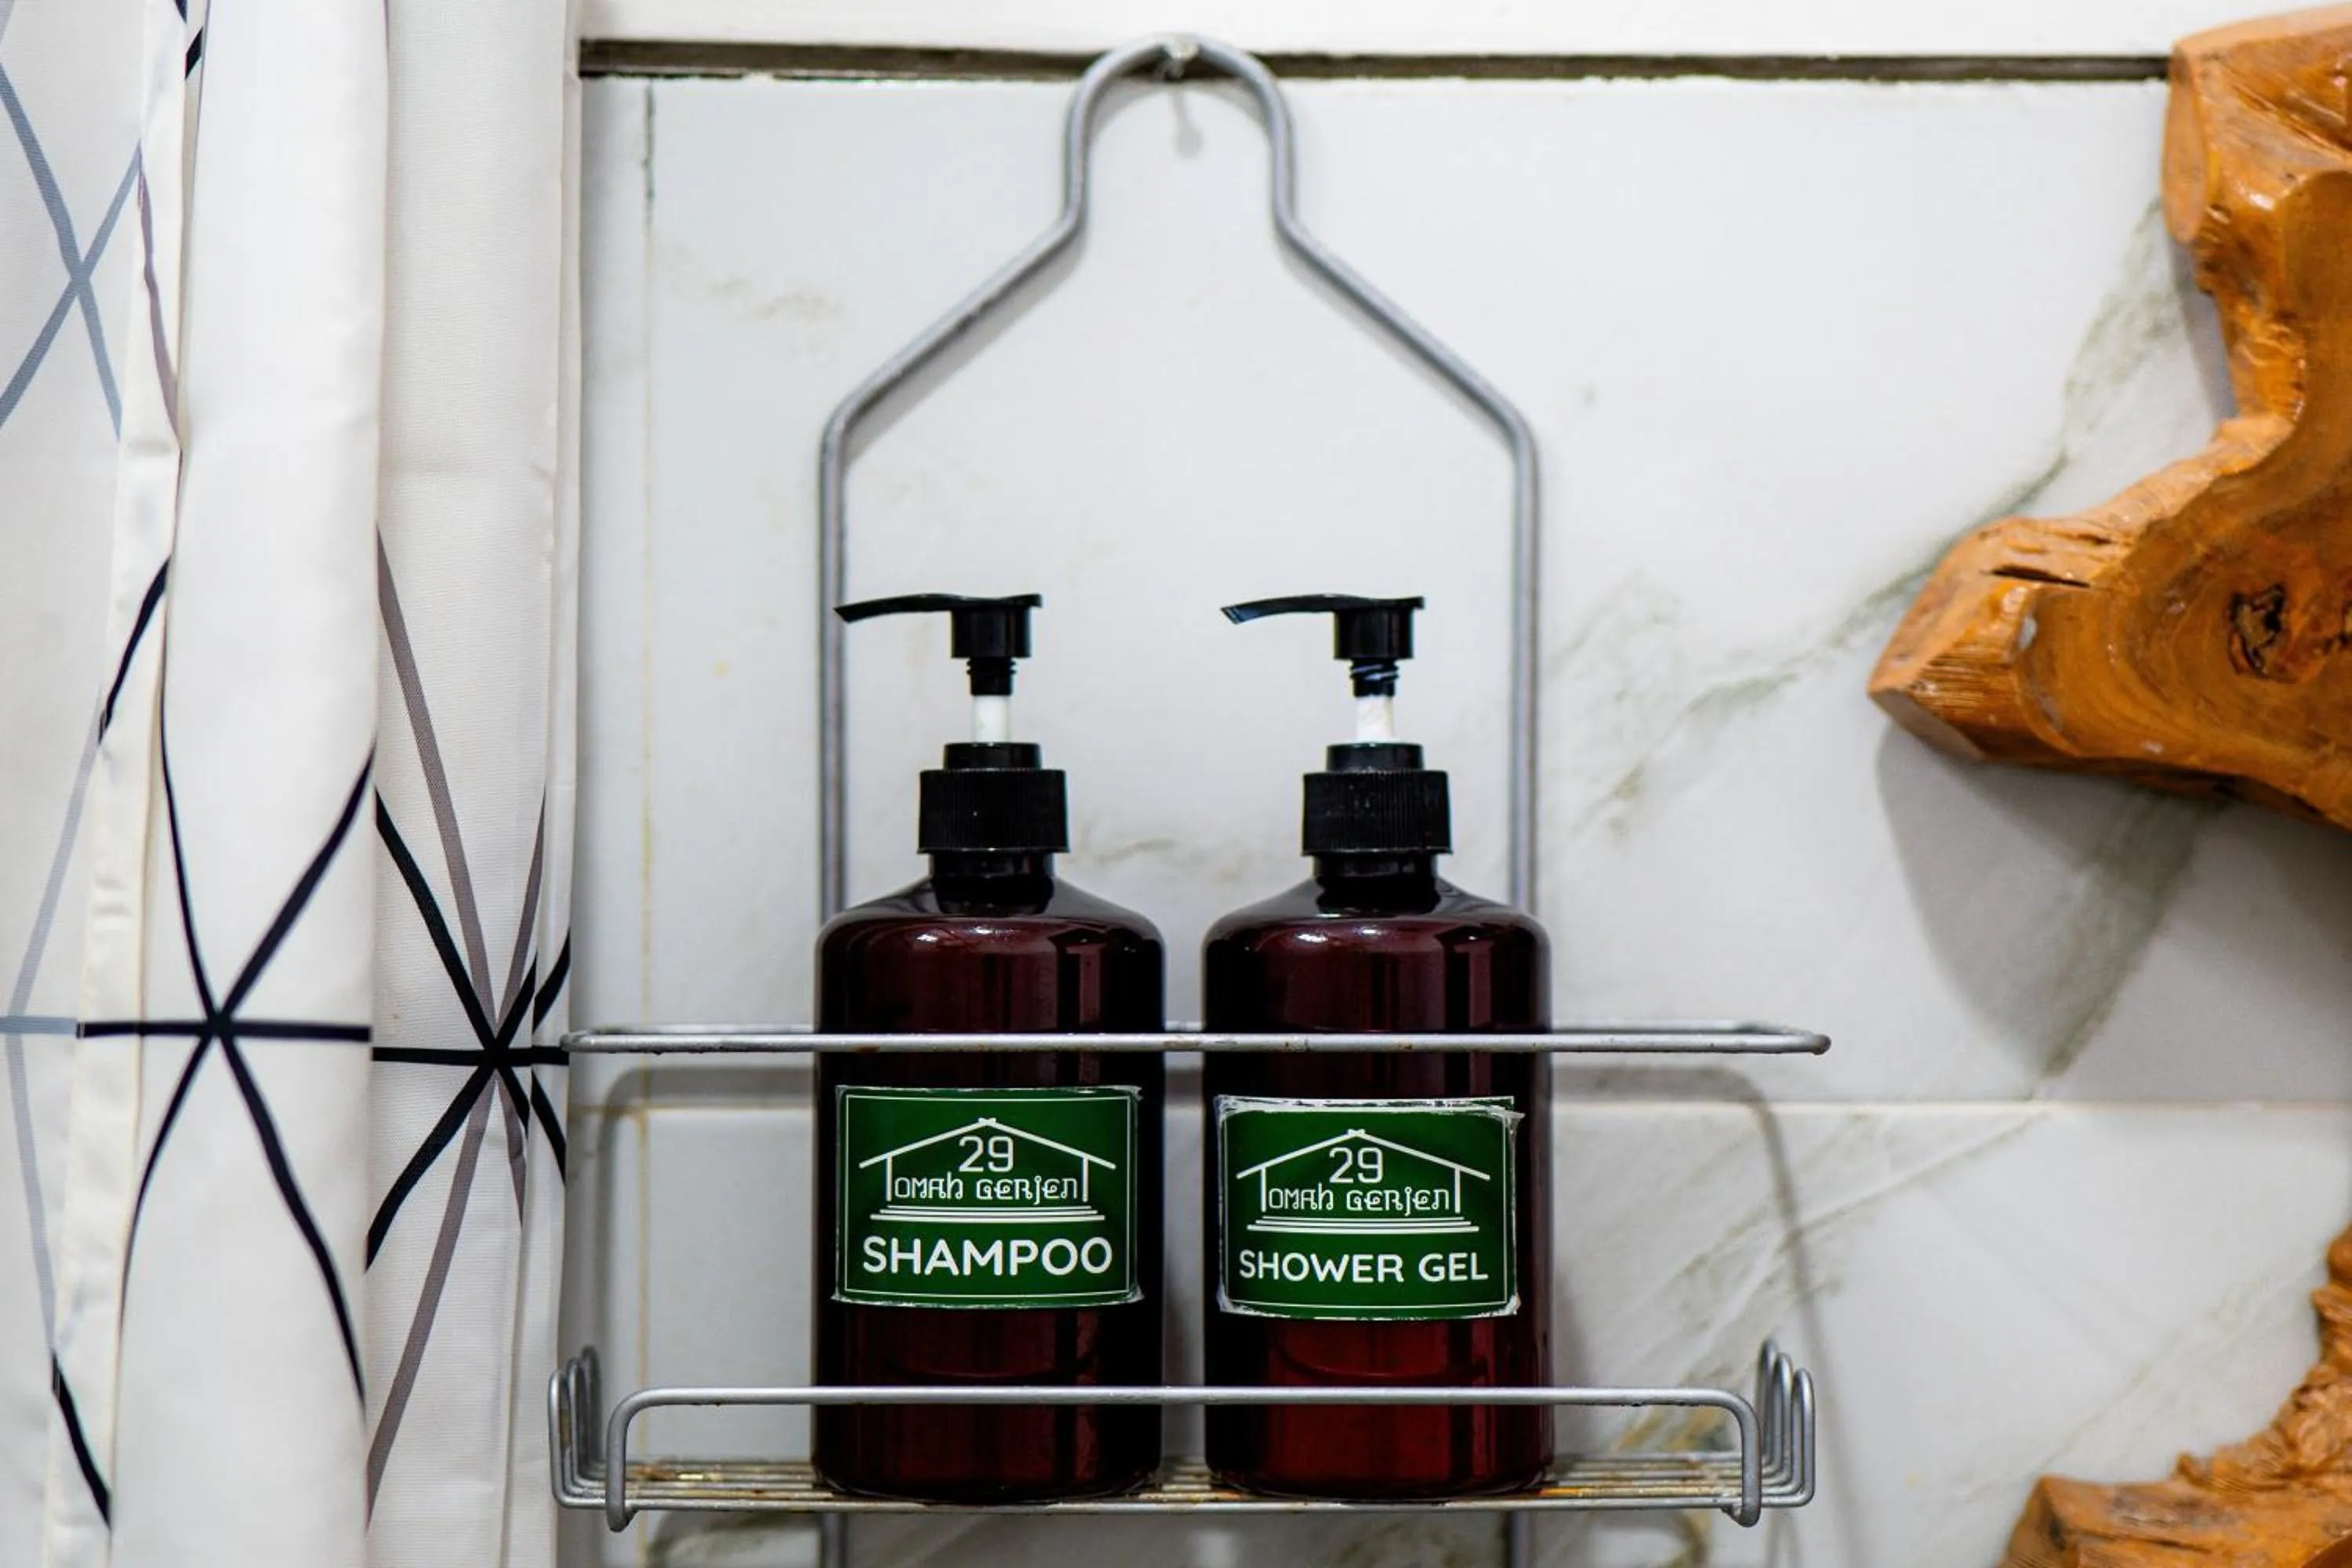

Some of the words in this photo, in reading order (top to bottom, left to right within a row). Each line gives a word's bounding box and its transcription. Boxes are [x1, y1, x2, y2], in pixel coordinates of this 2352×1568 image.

[958, 1135, 1015, 1173] 29
[1328, 1146, 1384, 1184] 29
[862, 1235, 1113, 1276] SHAMPOO
[1239, 1249, 1405, 1283] SHOWER
[1417, 1252, 1490, 1283] GEL
